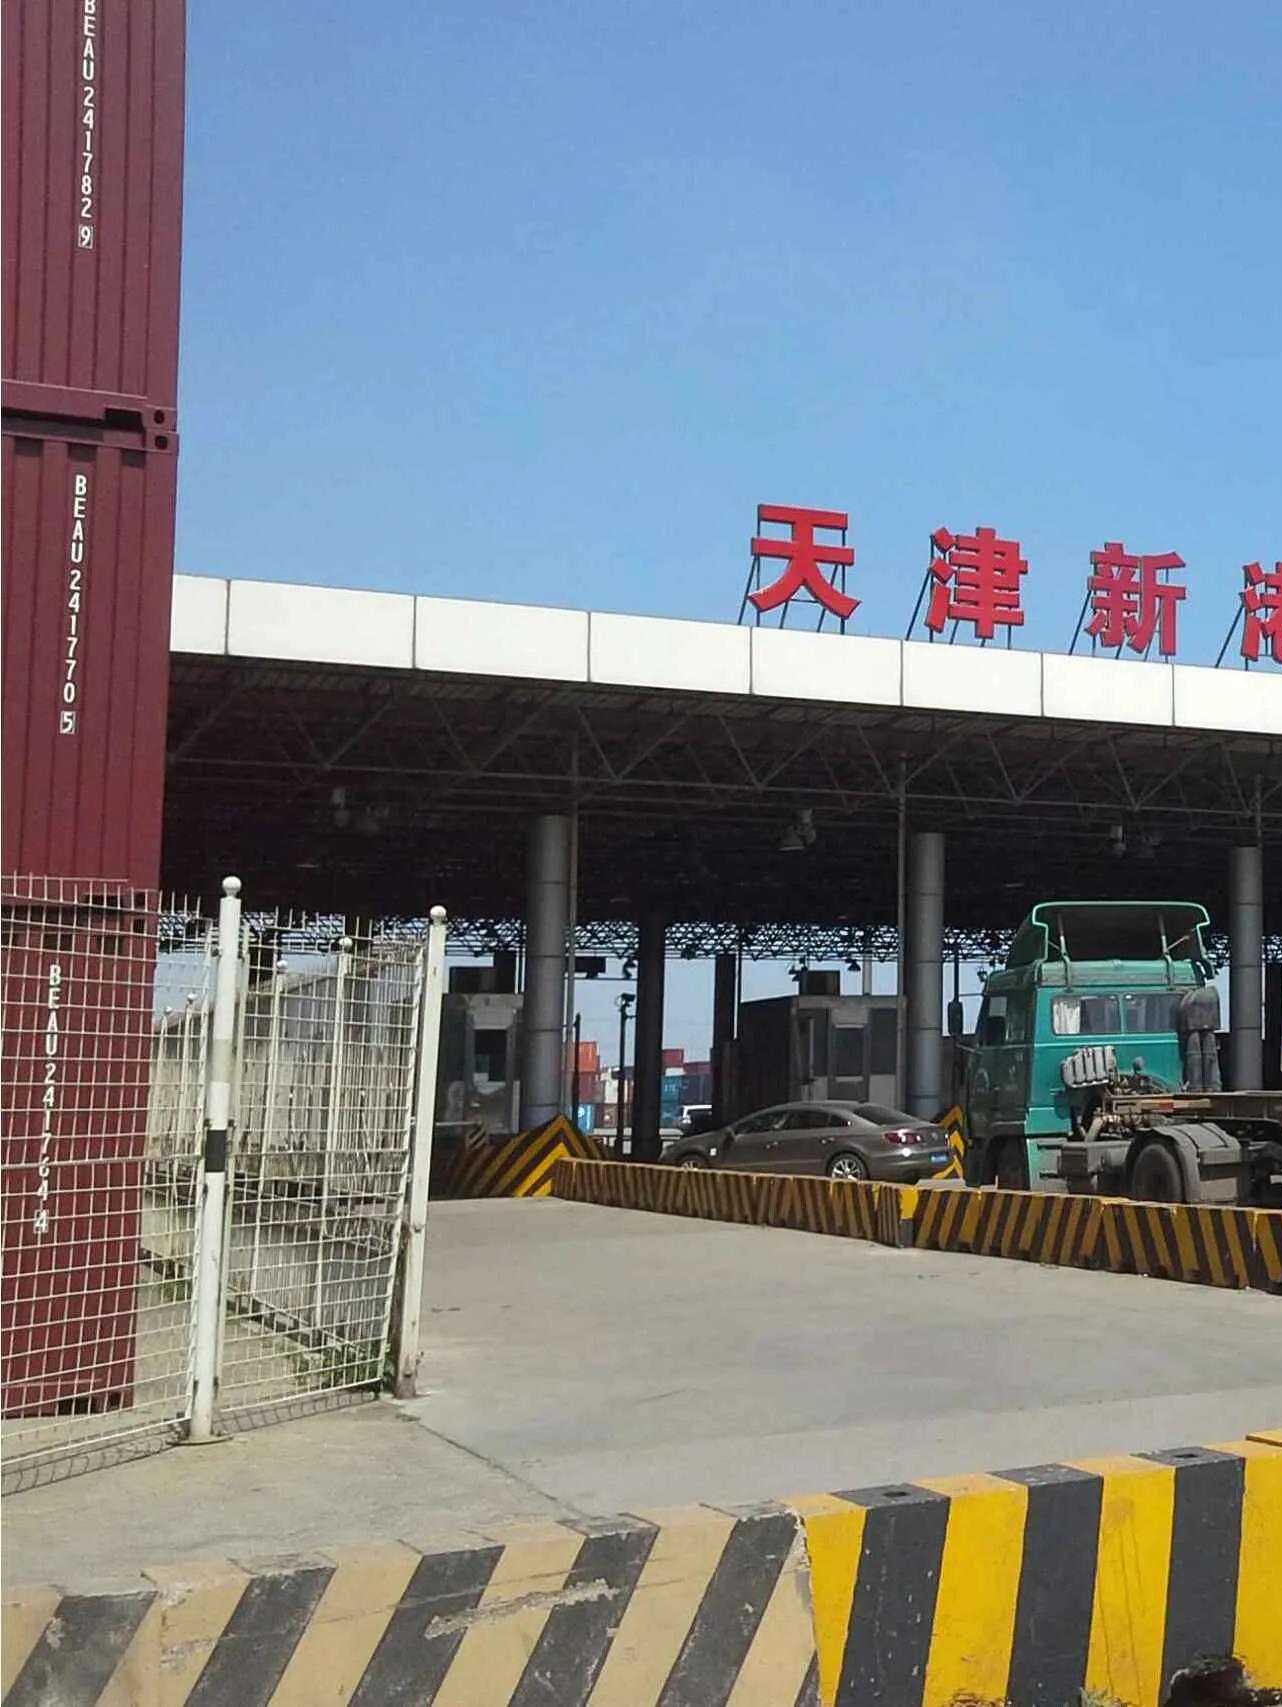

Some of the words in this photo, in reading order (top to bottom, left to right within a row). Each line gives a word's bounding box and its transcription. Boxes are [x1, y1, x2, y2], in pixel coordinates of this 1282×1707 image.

[82, 0, 97, 81] BEAU
[80, 86, 95, 218] 241782
[79, 225, 92, 248] 9
[70, 474, 88, 564] BEAU
[62, 569, 82, 704] 241770
[61, 712, 75, 734] 5
[45, 963, 62, 1056] BEAU
[36, 1062, 56, 1202] 241764
